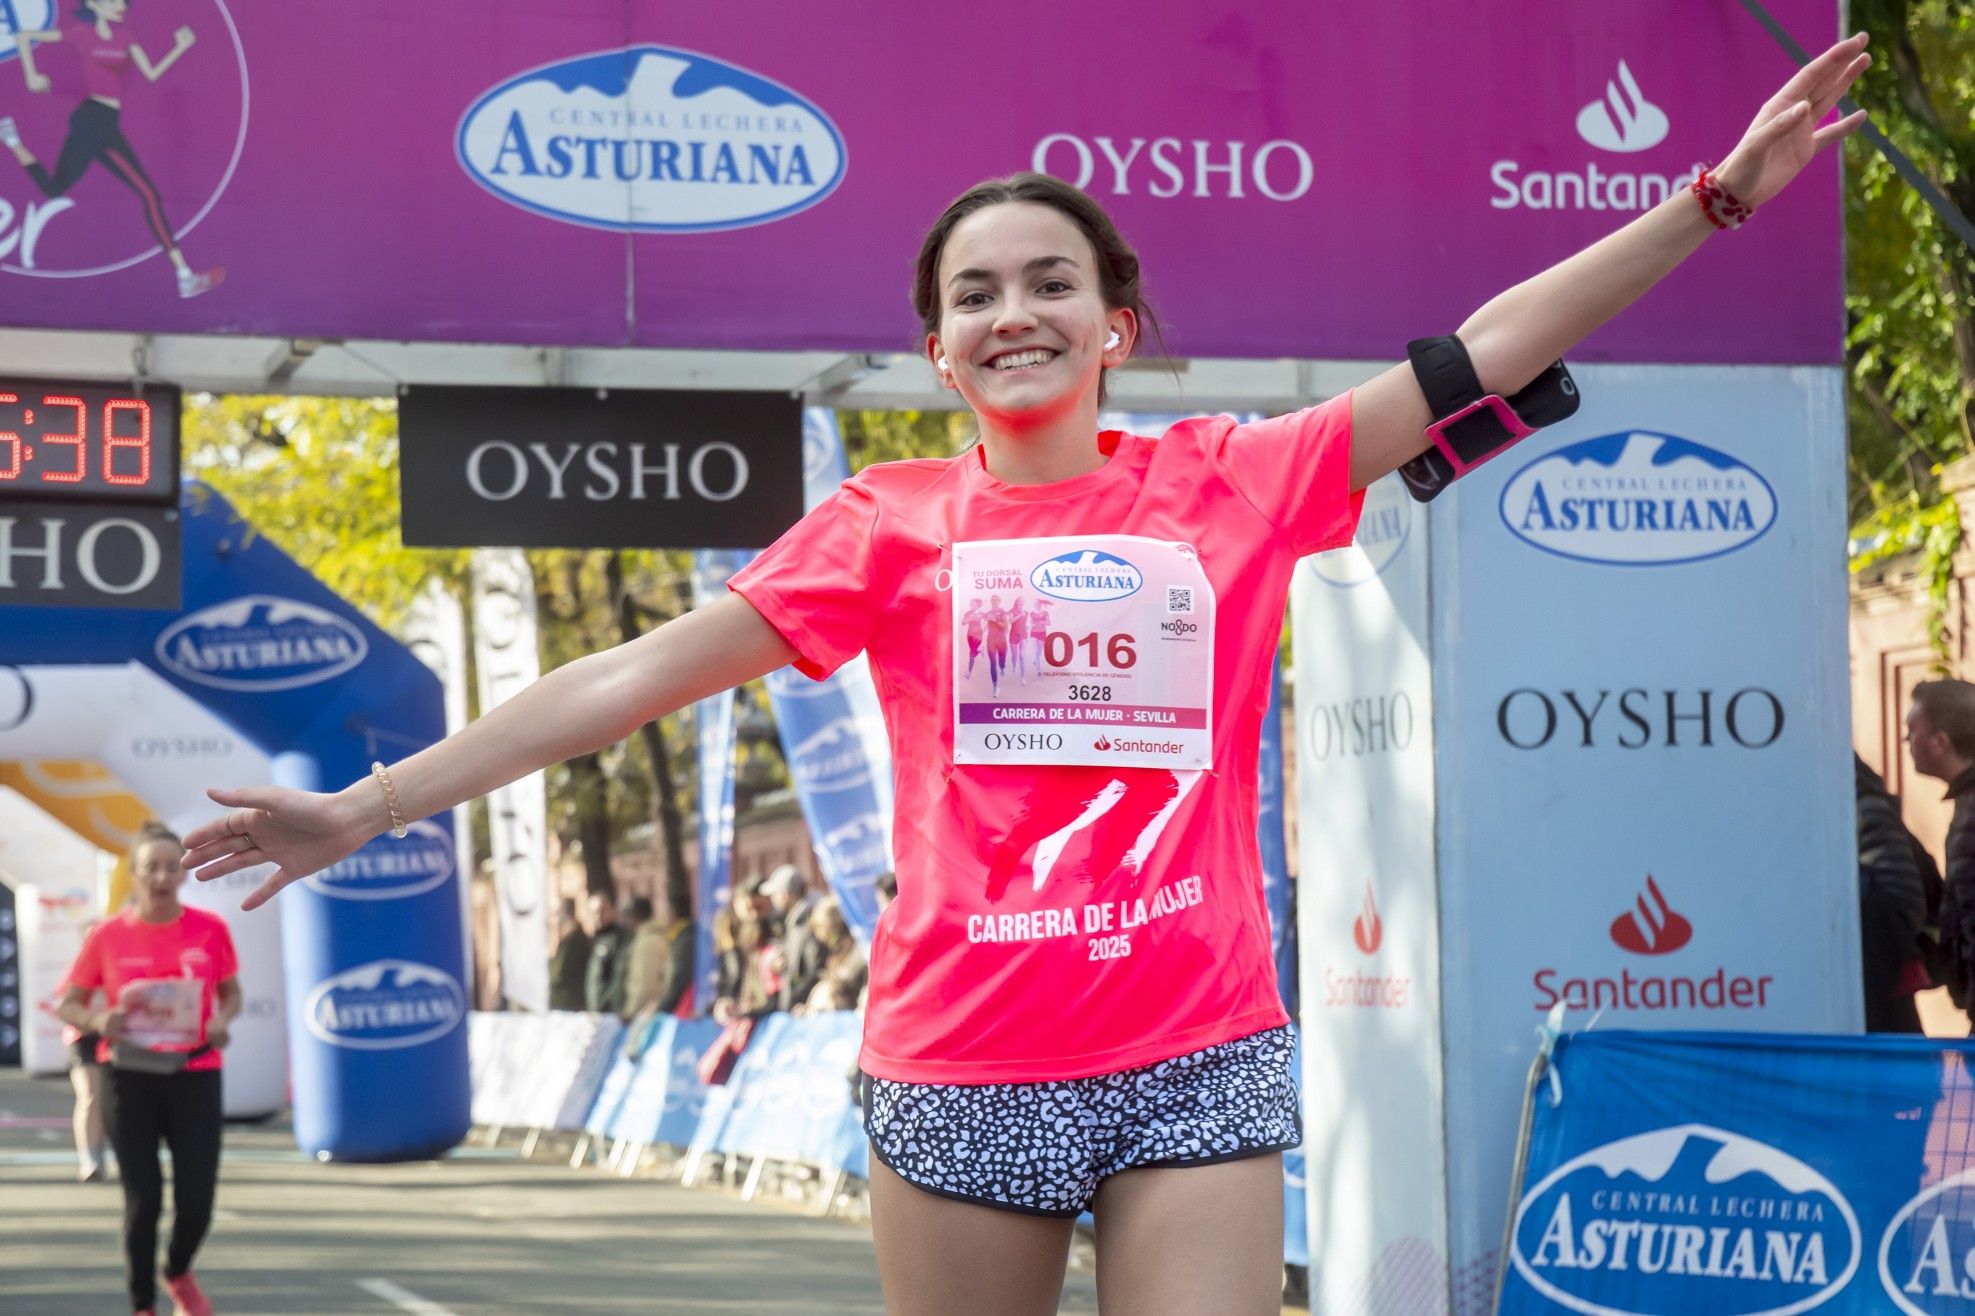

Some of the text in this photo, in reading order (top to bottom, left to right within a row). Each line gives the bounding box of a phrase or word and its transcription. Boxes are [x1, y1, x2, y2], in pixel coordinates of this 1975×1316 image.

[549, 107, 803, 133] CENTRAL LECHERA
[489, 109, 816, 186] ASTURIANA
[1030, 132, 1314, 201] OYSHO
[466, 440, 750, 501] OYSHO
[1562, 477, 1747, 491] CENTRAL LECHERA
[1520, 480, 1756, 532] ASTURIANA
[974, 577, 1024, 589] SUMA
[1039, 568, 1135, 589] ASTURIANA
[1044, 631, 1137, 669] 016
[1068, 685, 1112, 701] 3628
[993, 708, 1177, 724] CARRERA DE LA MUJER SEVILLA
[1311, 690, 1413, 761] OYSHO
[1496, 686, 1785, 750] OYSHO
[984, 733, 1063, 751] OYSHO
[1113, 738, 1185, 754] Santander
[967, 907, 1078, 944] CARRERA
[1084, 903, 1114, 934] DE
[1120, 898, 1149, 930] LA
[1088, 934, 1131, 962] 2025
[1533, 967, 1773, 1012] Santander
[1592, 1189, 1825, 1223] CENTRAL LECHERA
[1531, 1192, 1830, 1285] ASTURIANA
